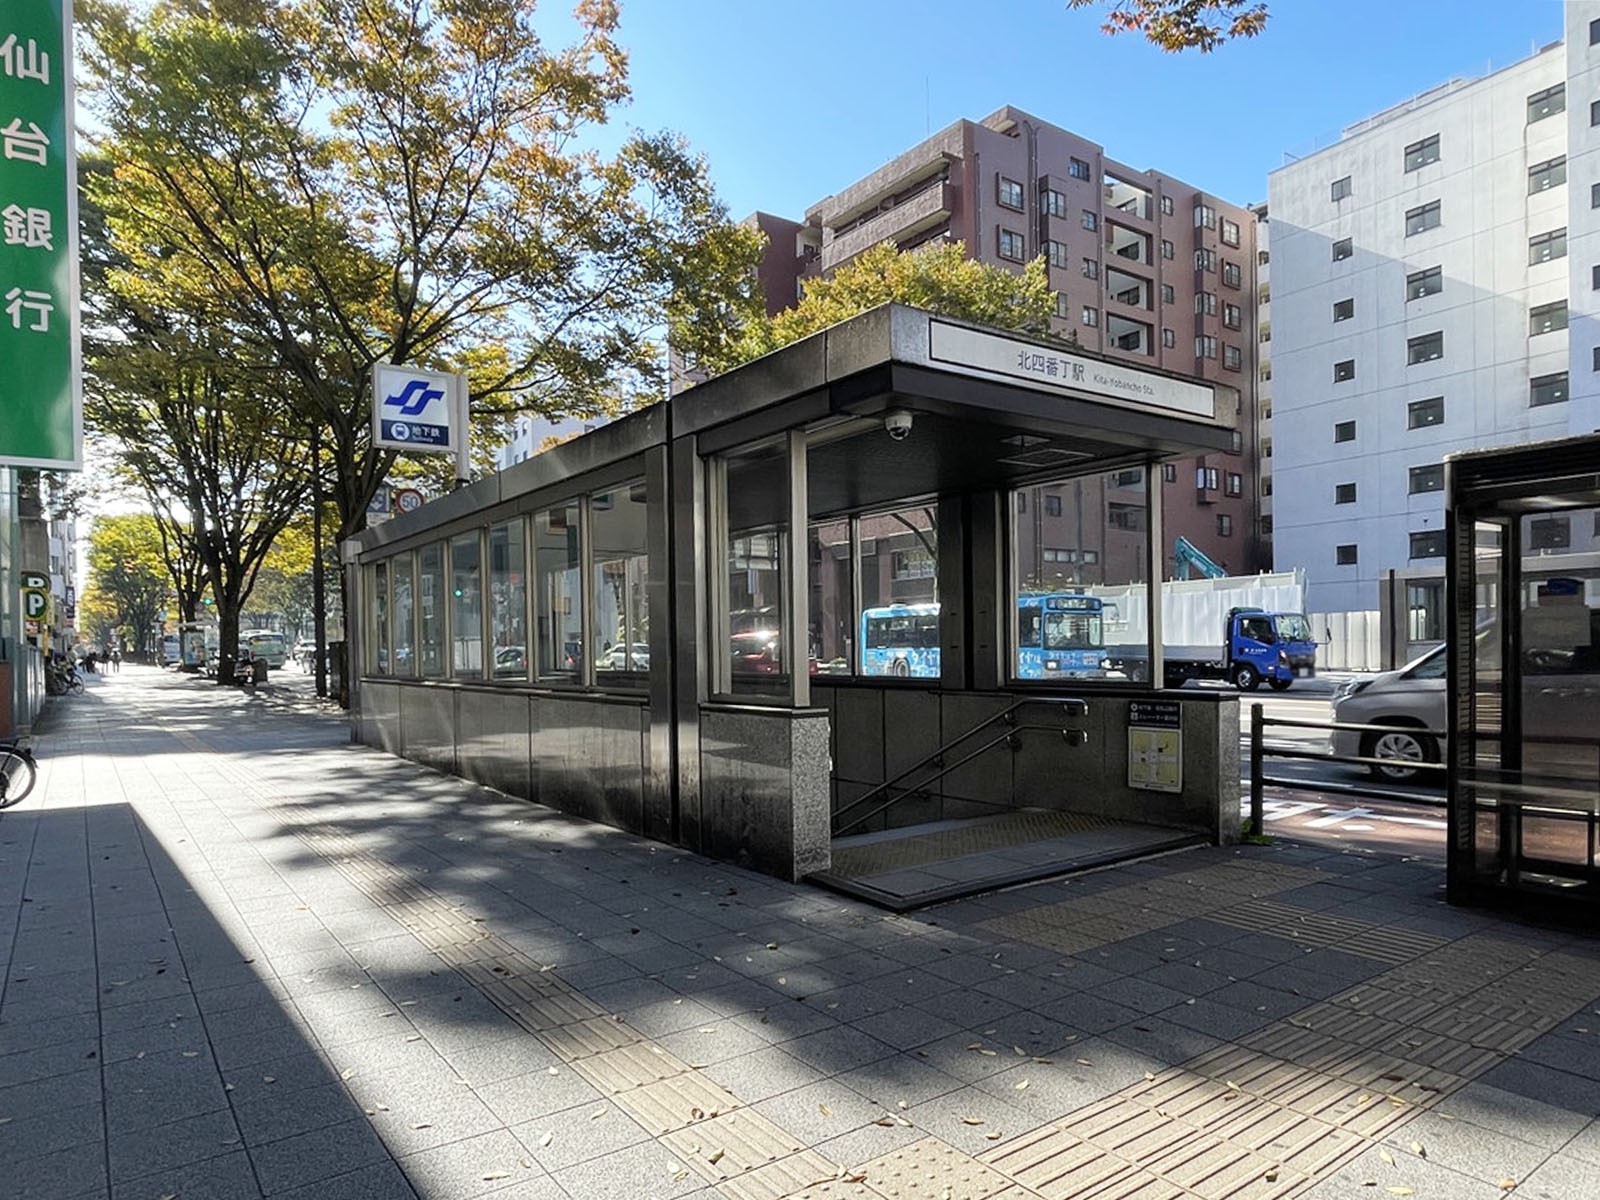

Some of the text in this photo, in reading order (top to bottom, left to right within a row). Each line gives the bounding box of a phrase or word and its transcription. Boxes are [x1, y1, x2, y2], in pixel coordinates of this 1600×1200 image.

[0, 33, 54, 332] 仙台銀行
[1017, 350, 1085, 382] 北四番丁駅
[402, 495, 419, 508] 50
[28, 593, 44, 615] P
